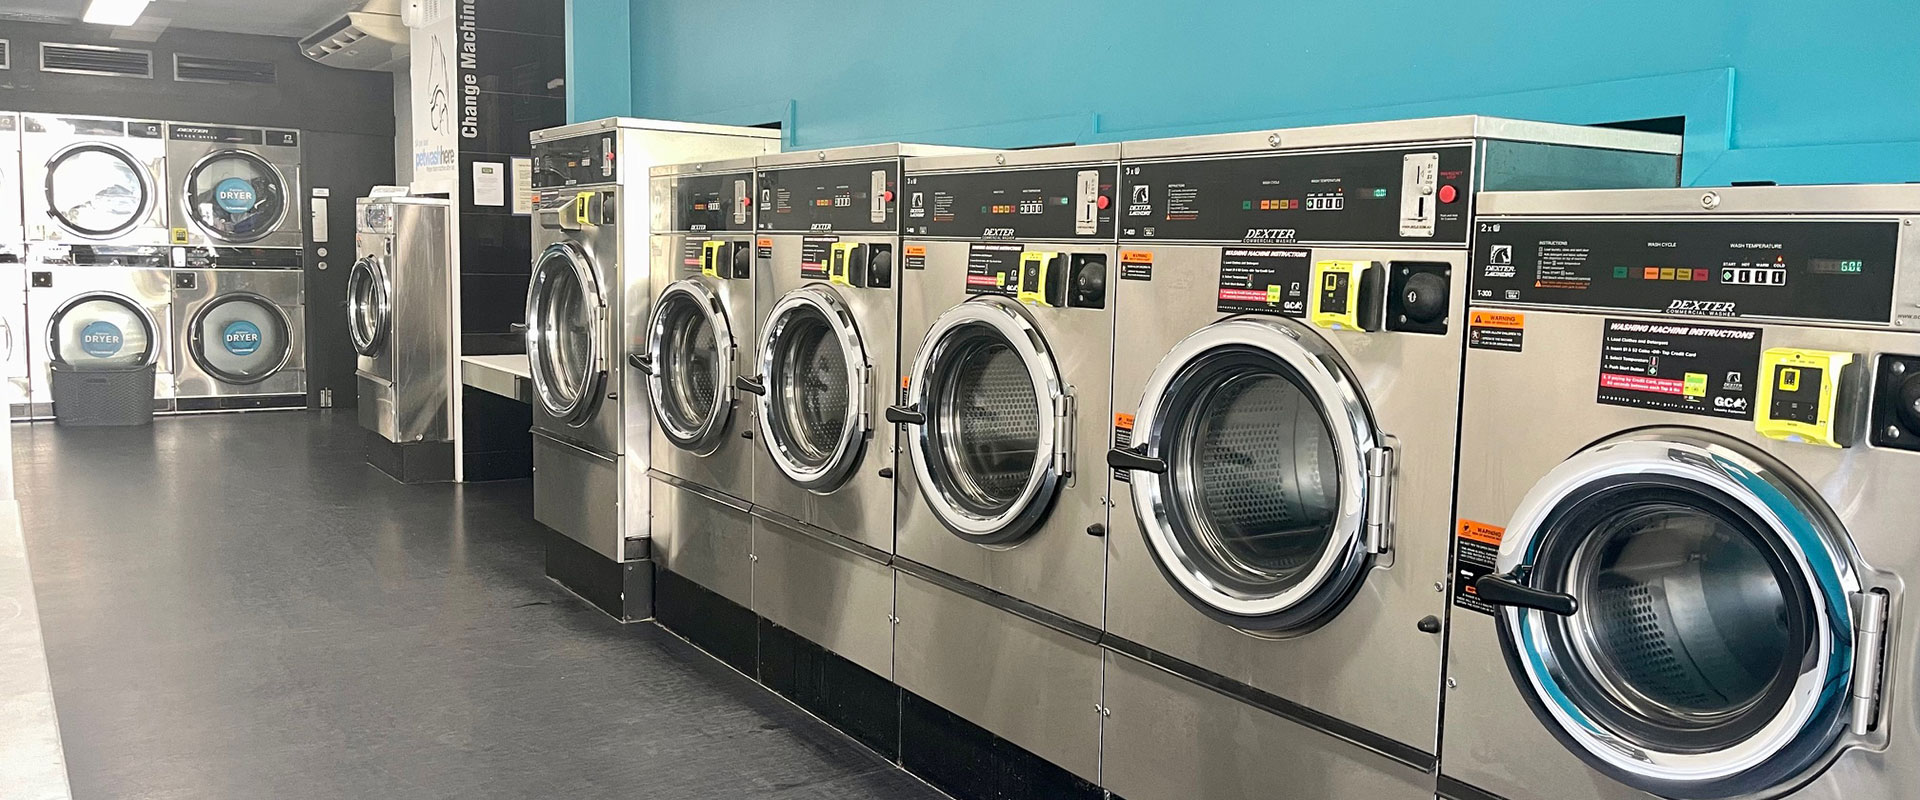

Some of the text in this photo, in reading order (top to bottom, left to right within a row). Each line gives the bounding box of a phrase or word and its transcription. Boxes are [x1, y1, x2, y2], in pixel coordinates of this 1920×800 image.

[462, 74, 480, 138] Change
[1245, 229, 1295, 238] DEXTER
[1668, 300, 1736, 312] DEXTER
[1610, 323, 1755, 339] WASHING MACHINE INSTRUCTIONS
[85, 335, 119, 343] DRYER
[226, 334, 257, 342] DRYER
